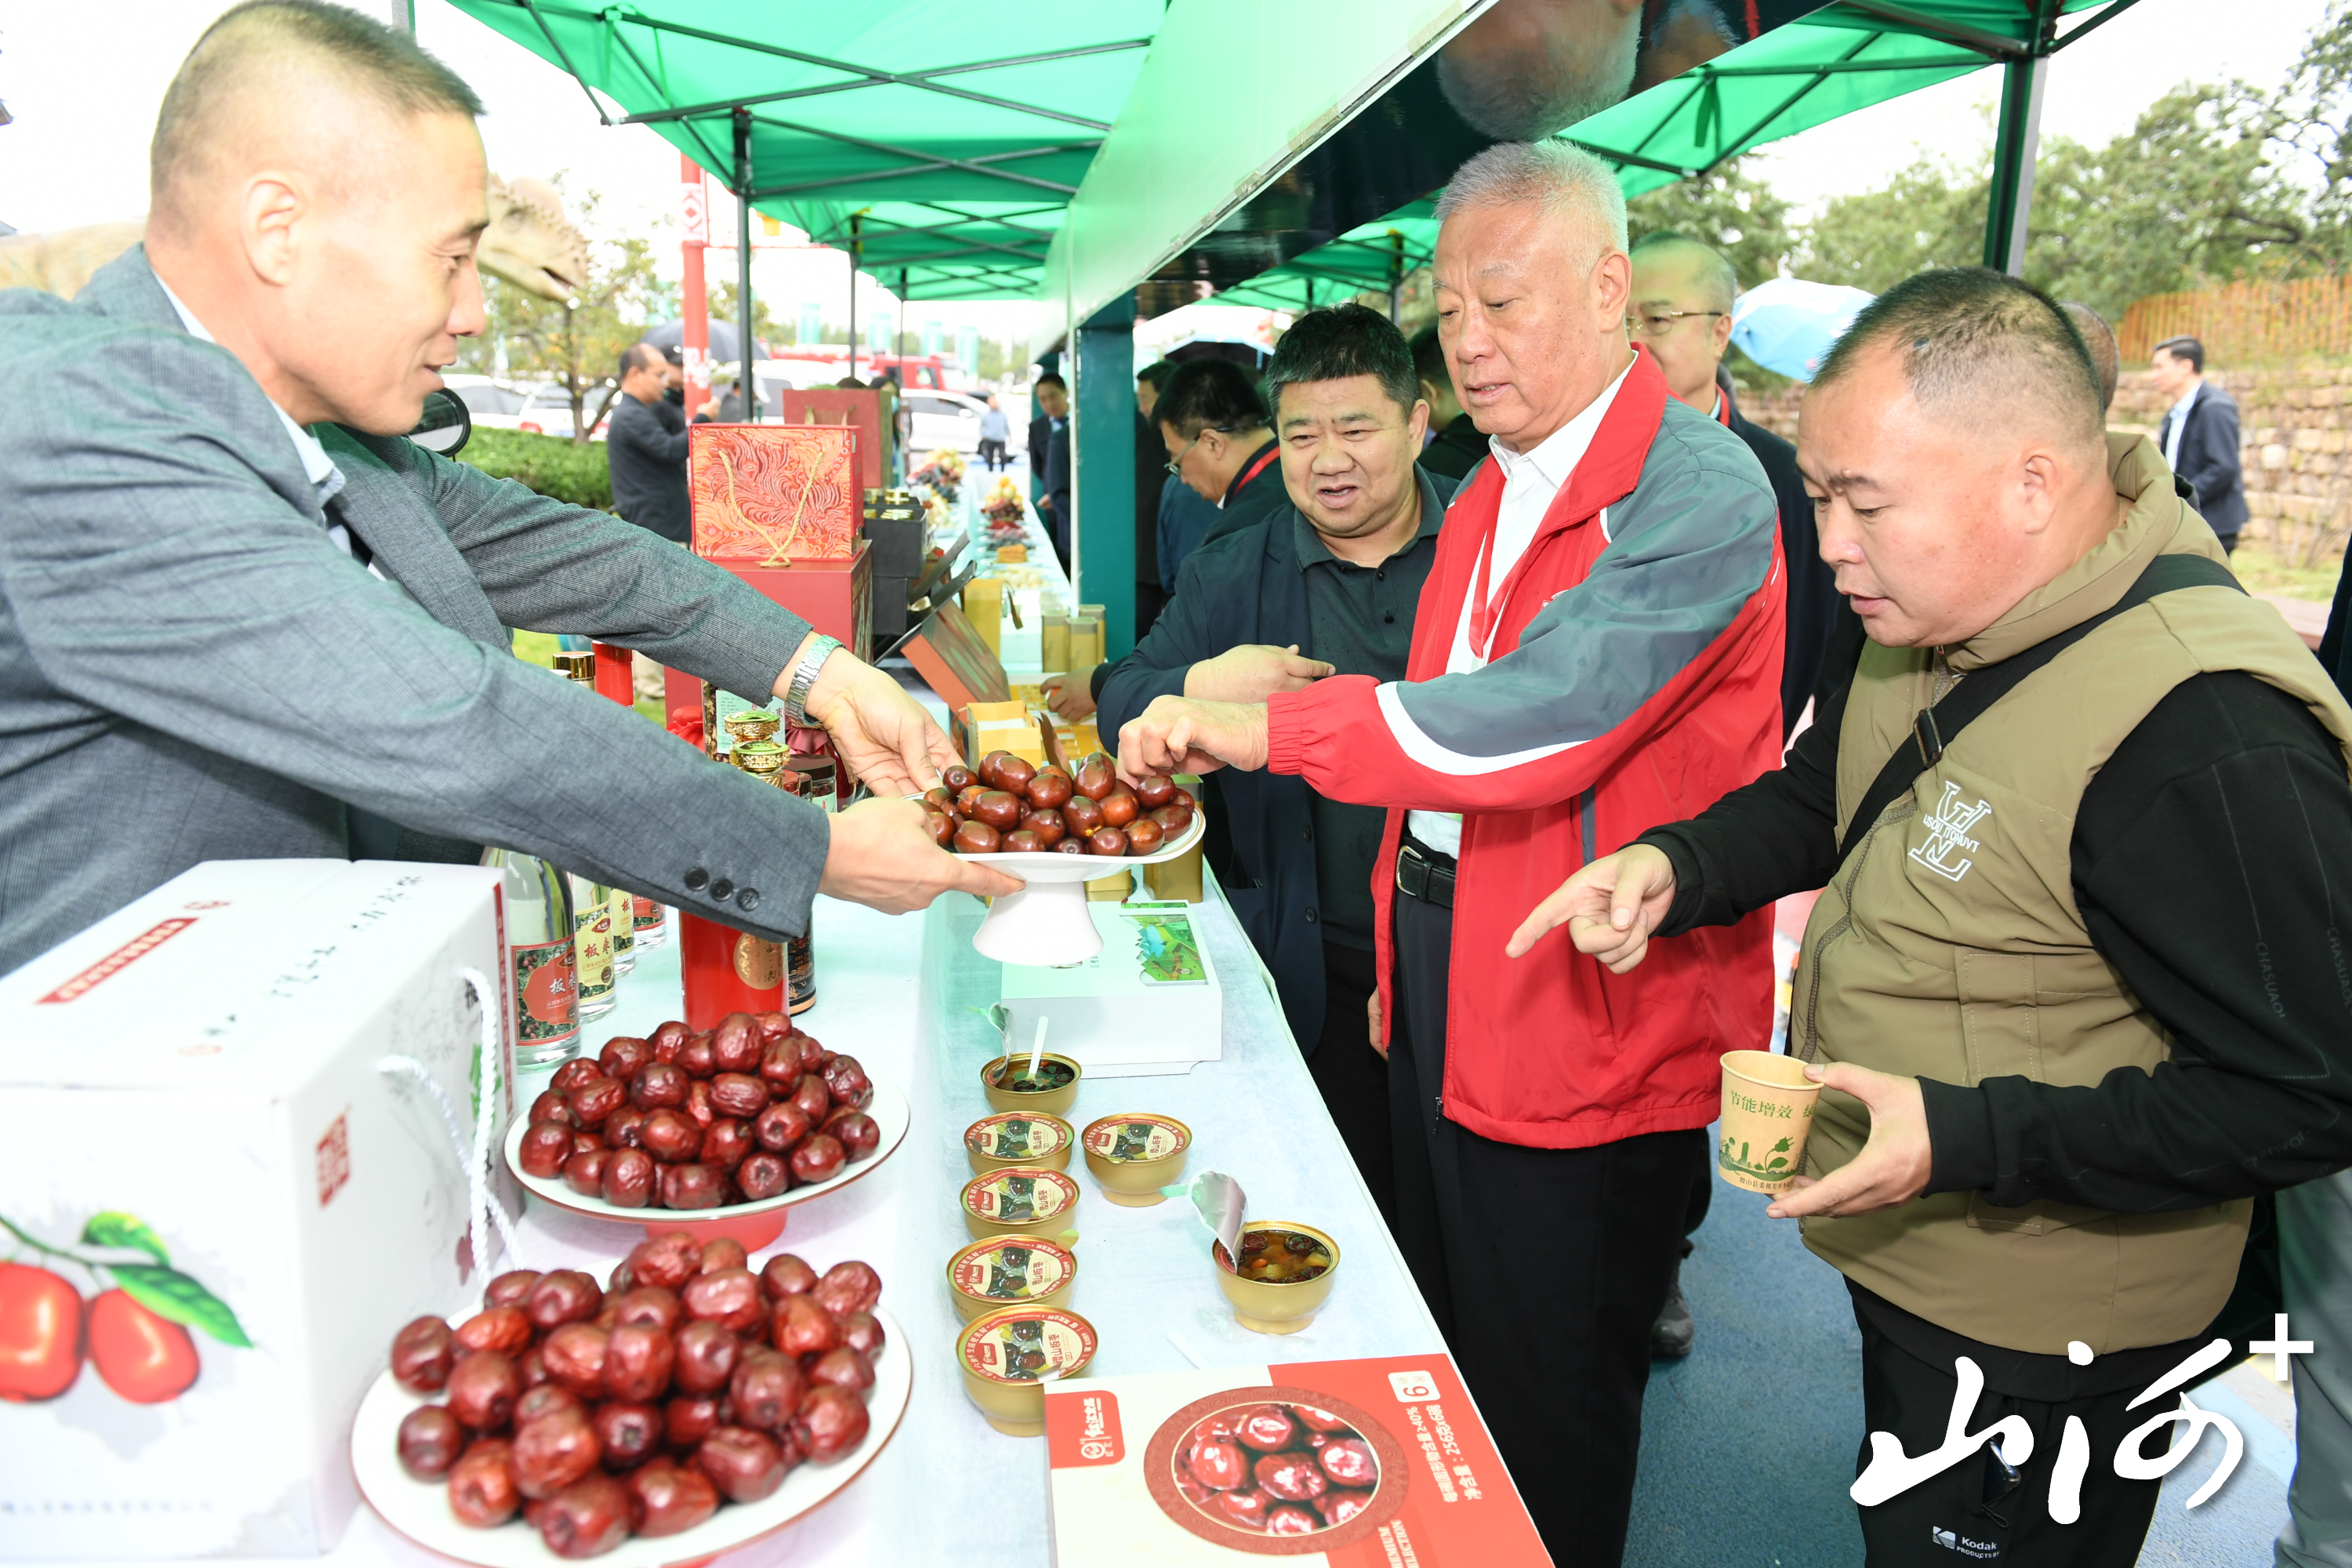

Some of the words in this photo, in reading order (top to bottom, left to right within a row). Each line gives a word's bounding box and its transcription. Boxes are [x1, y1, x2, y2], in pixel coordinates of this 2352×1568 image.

[583, 937, 611, 959] 板枣
[549, 971, 577, 996] 板枣
[1730, 1090, 1794, 1119] 节能增效
[1047, 1334, 1065, 1366] 稷山板枣
[1403, 1385, 1429, 1398] 6
[1377, 1526, 1404, 1568] REMIUM
[1390, 1519, 1421, 1568] ELECTION
[1956, 1545, 1992, 1559] PRODUCTS
[1962, 1537, 1998, 1551] Kodak
